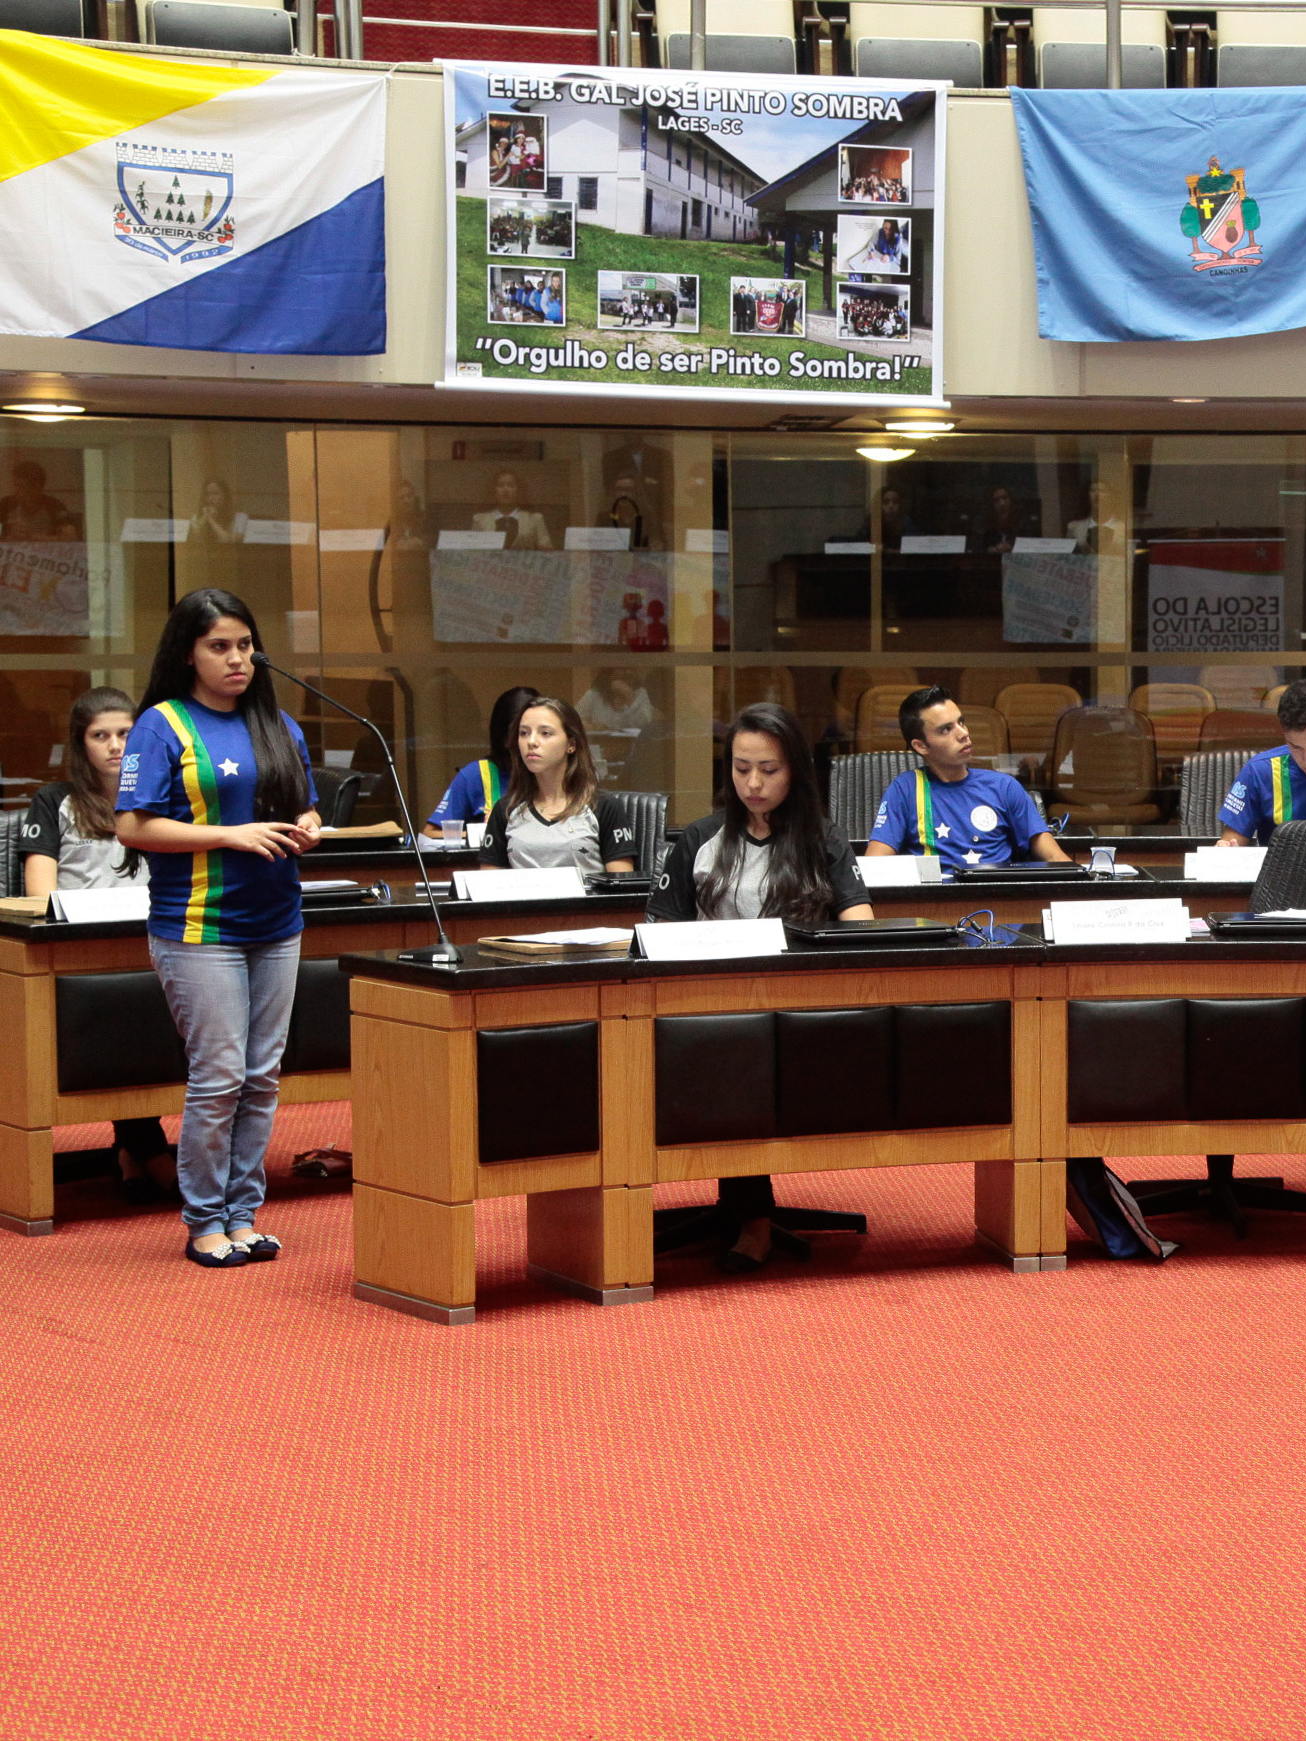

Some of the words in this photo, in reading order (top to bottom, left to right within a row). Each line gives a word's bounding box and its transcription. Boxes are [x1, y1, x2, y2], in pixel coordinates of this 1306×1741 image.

[488, 74, 563, 101] E.E.B.
[569, 79, 626, 106] GAL
[631, 81, 699, 109] JOSÉ
[705, 88, 787, 115] PINTO
[791, 92, 904, 122] SOMBRA
[657, 115, 710, 133] LAGES
[720, 119, 744, 135] SC
[133, 226, 215, 243] MACIEIRA-SC
[185, 249, 219, 260] 1992
[615, 343, 651, 372] de
[658, 352, 704, 374] ser
[709, 347, 782, 377] Pinto
